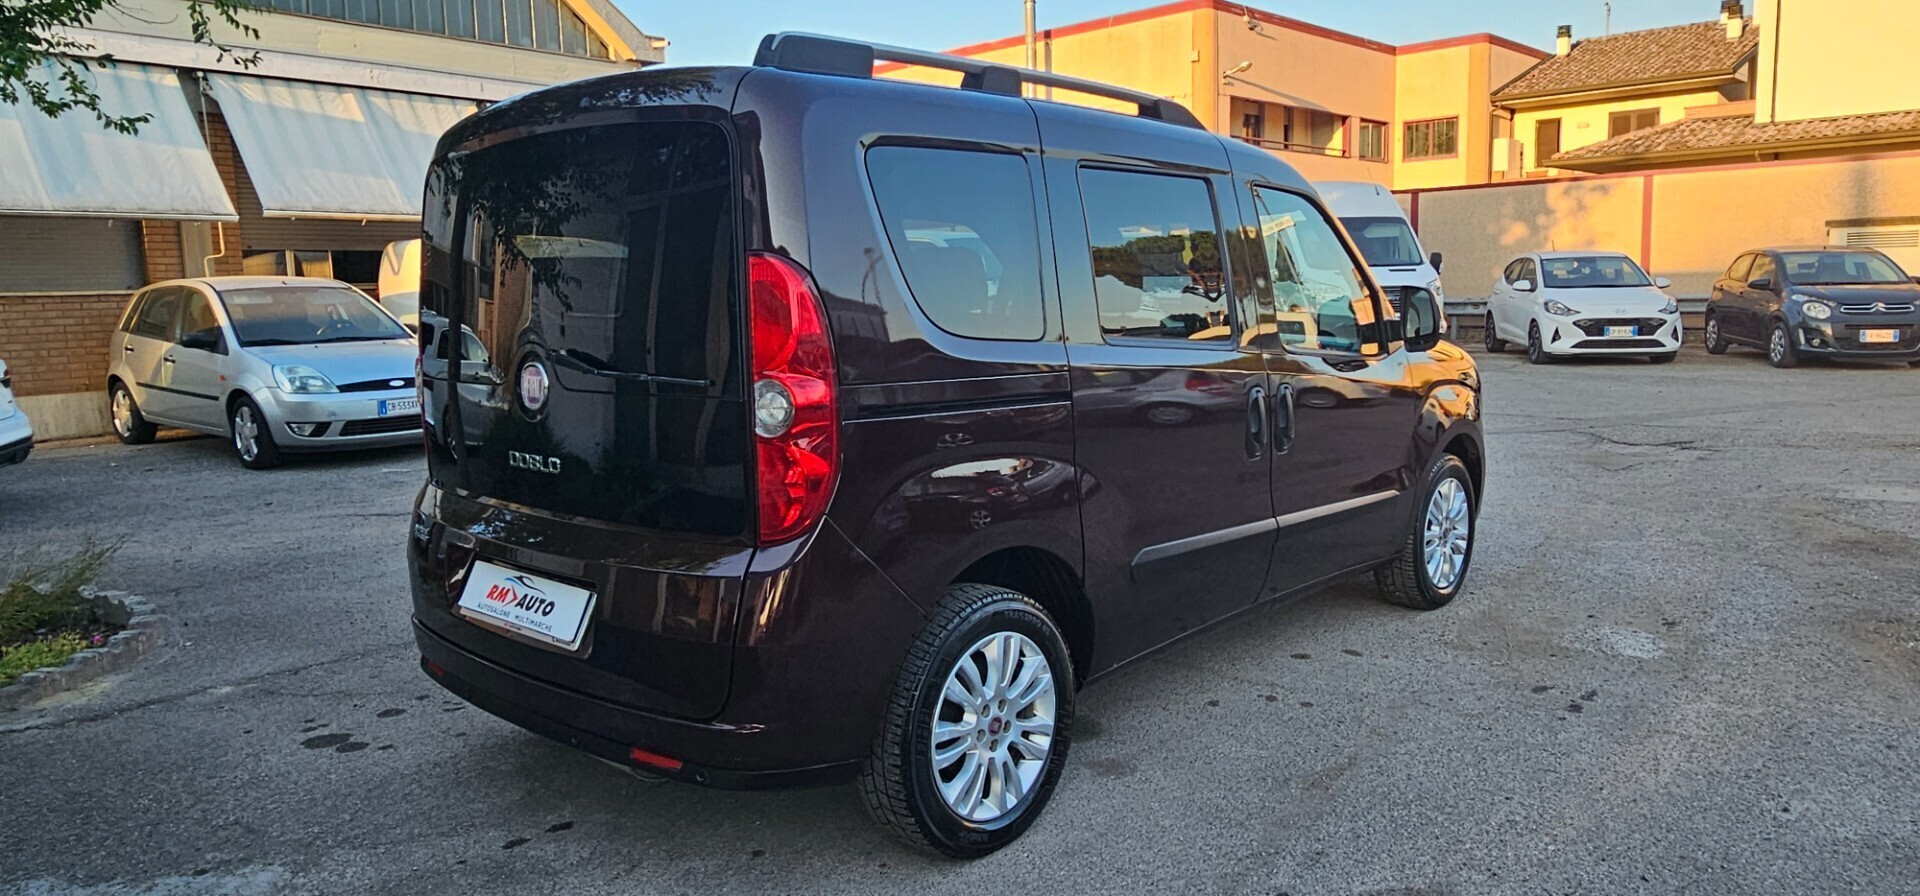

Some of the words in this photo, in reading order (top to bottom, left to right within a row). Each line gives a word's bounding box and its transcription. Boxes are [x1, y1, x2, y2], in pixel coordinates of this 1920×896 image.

[477, 602, 511, 619] AUTOSALONE
[515, 615, 553, 632] MULTIMARCHE
[515, 593, 556, 617] AUTO
